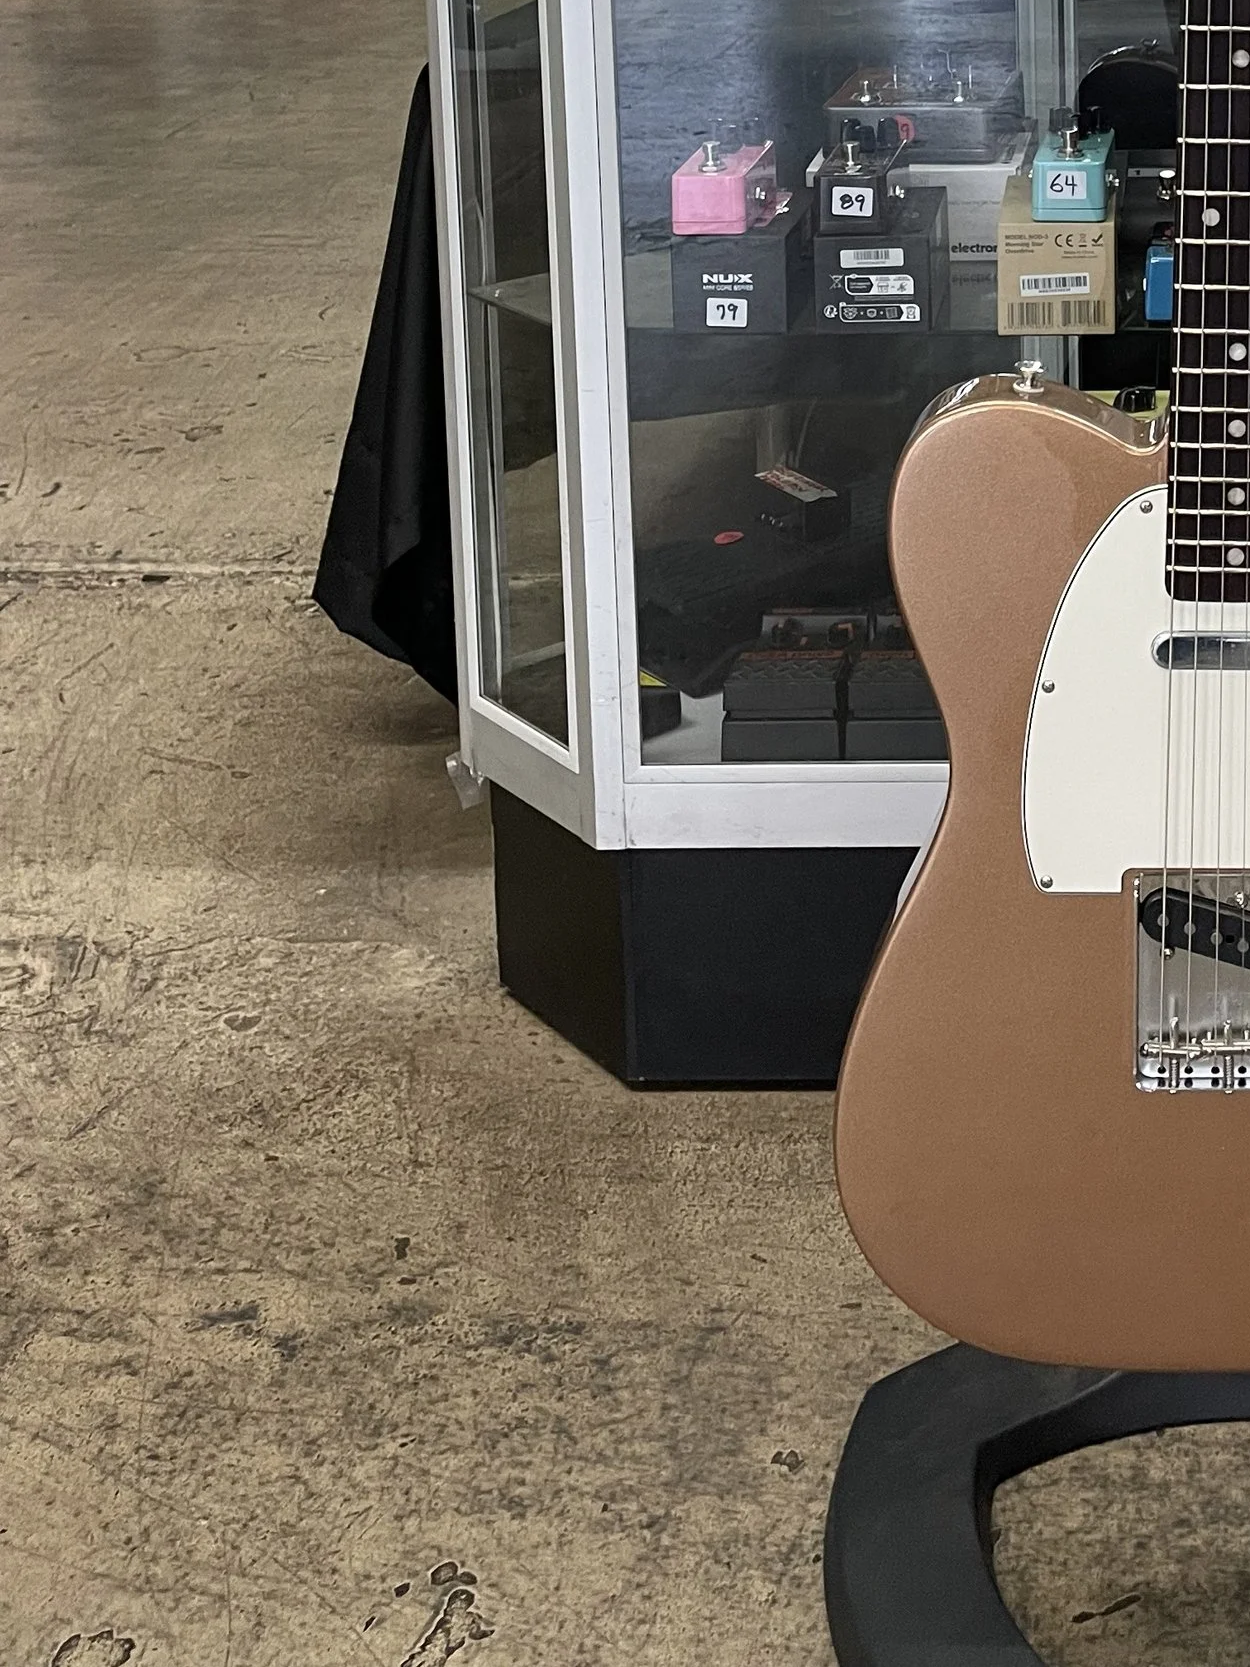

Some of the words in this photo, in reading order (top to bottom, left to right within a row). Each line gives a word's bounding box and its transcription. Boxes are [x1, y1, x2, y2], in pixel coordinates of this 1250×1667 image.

[1049, 172, 1078, 197] 64
[839, 193, 866, 212] 89
[702, 273, 754, 284] NUX
[716, 303, 739, 321] 79
